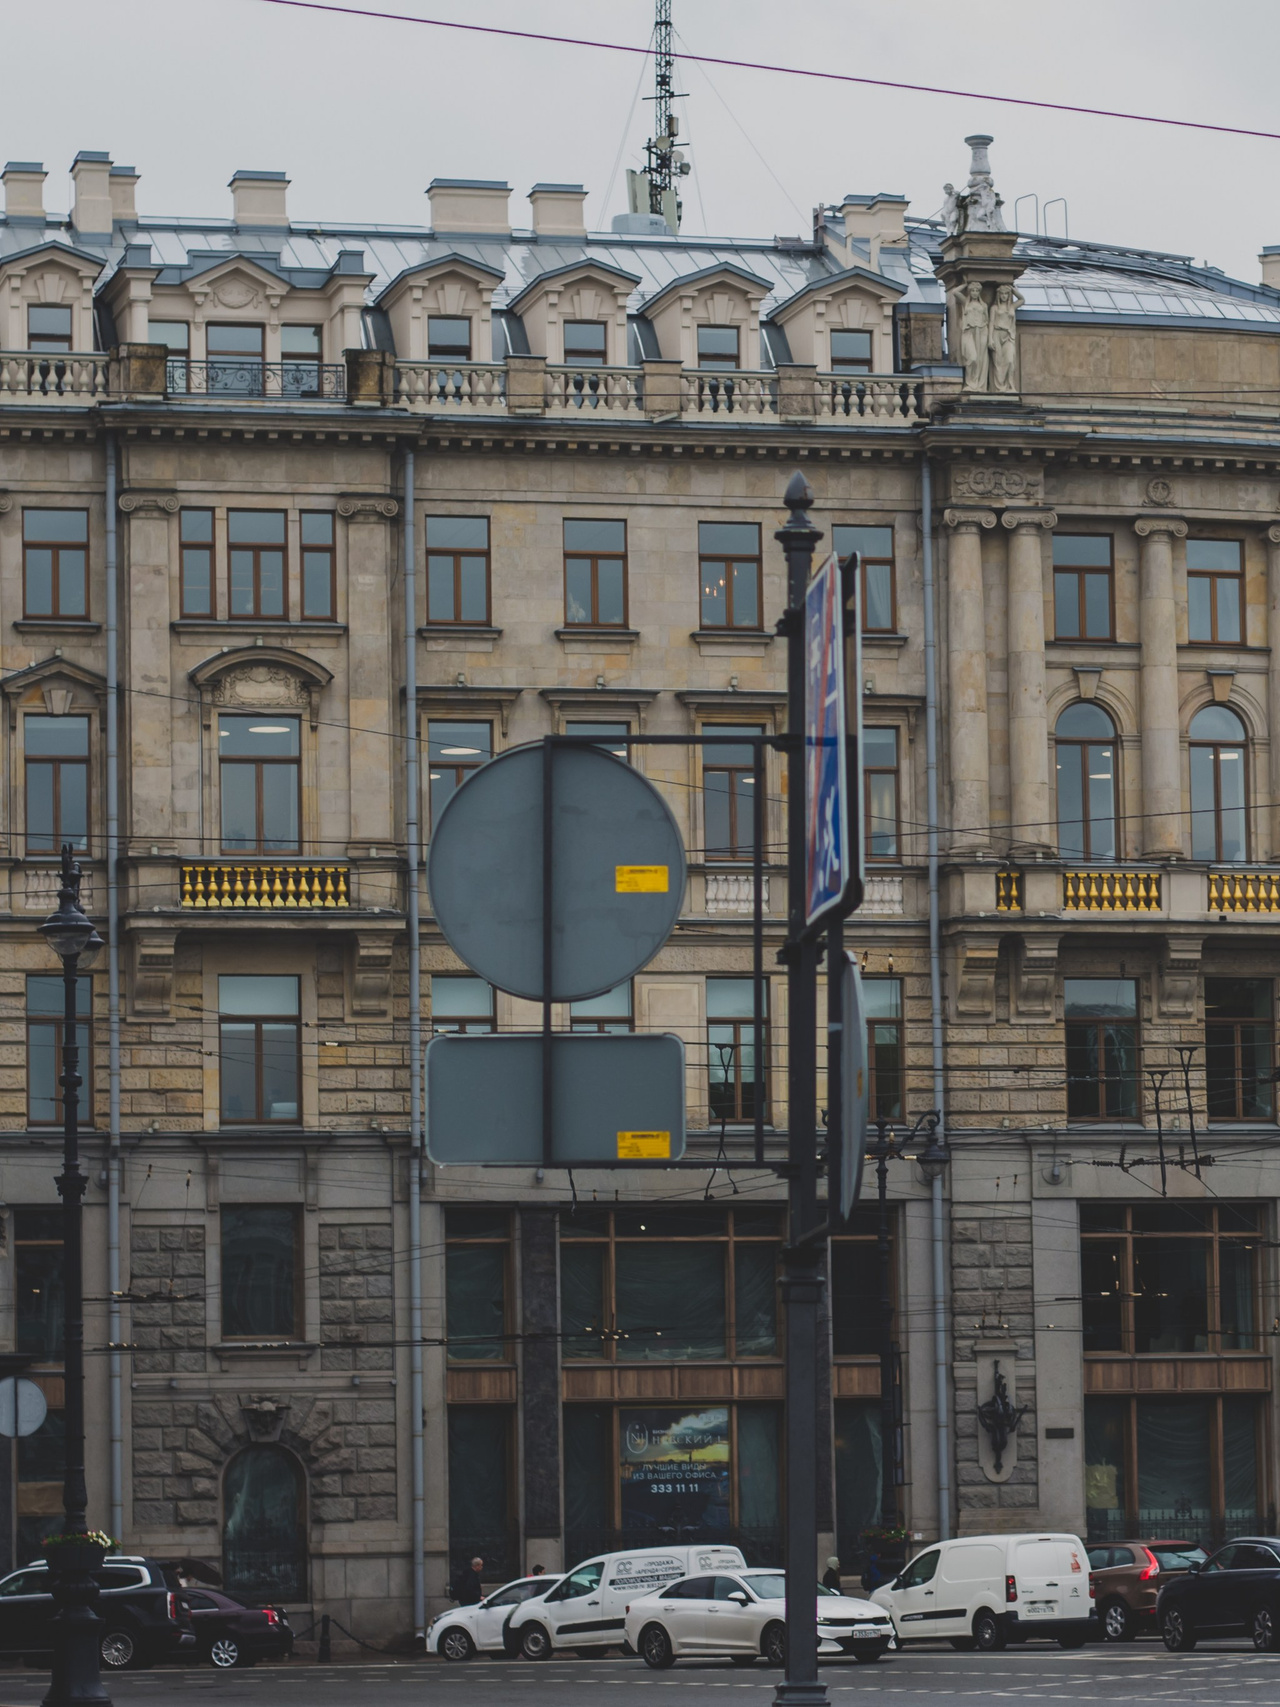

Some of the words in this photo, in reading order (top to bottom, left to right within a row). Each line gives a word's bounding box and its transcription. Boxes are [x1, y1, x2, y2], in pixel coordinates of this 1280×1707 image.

[681, 1463, 707, 1471] ВИДЫ
[685, 1471, 716, 1479] ОФИСА
[651, 1484, 672, 1493] 333
[675, 1484, 685, 1492] 11
[689, 1483, 699, 1492] 11
